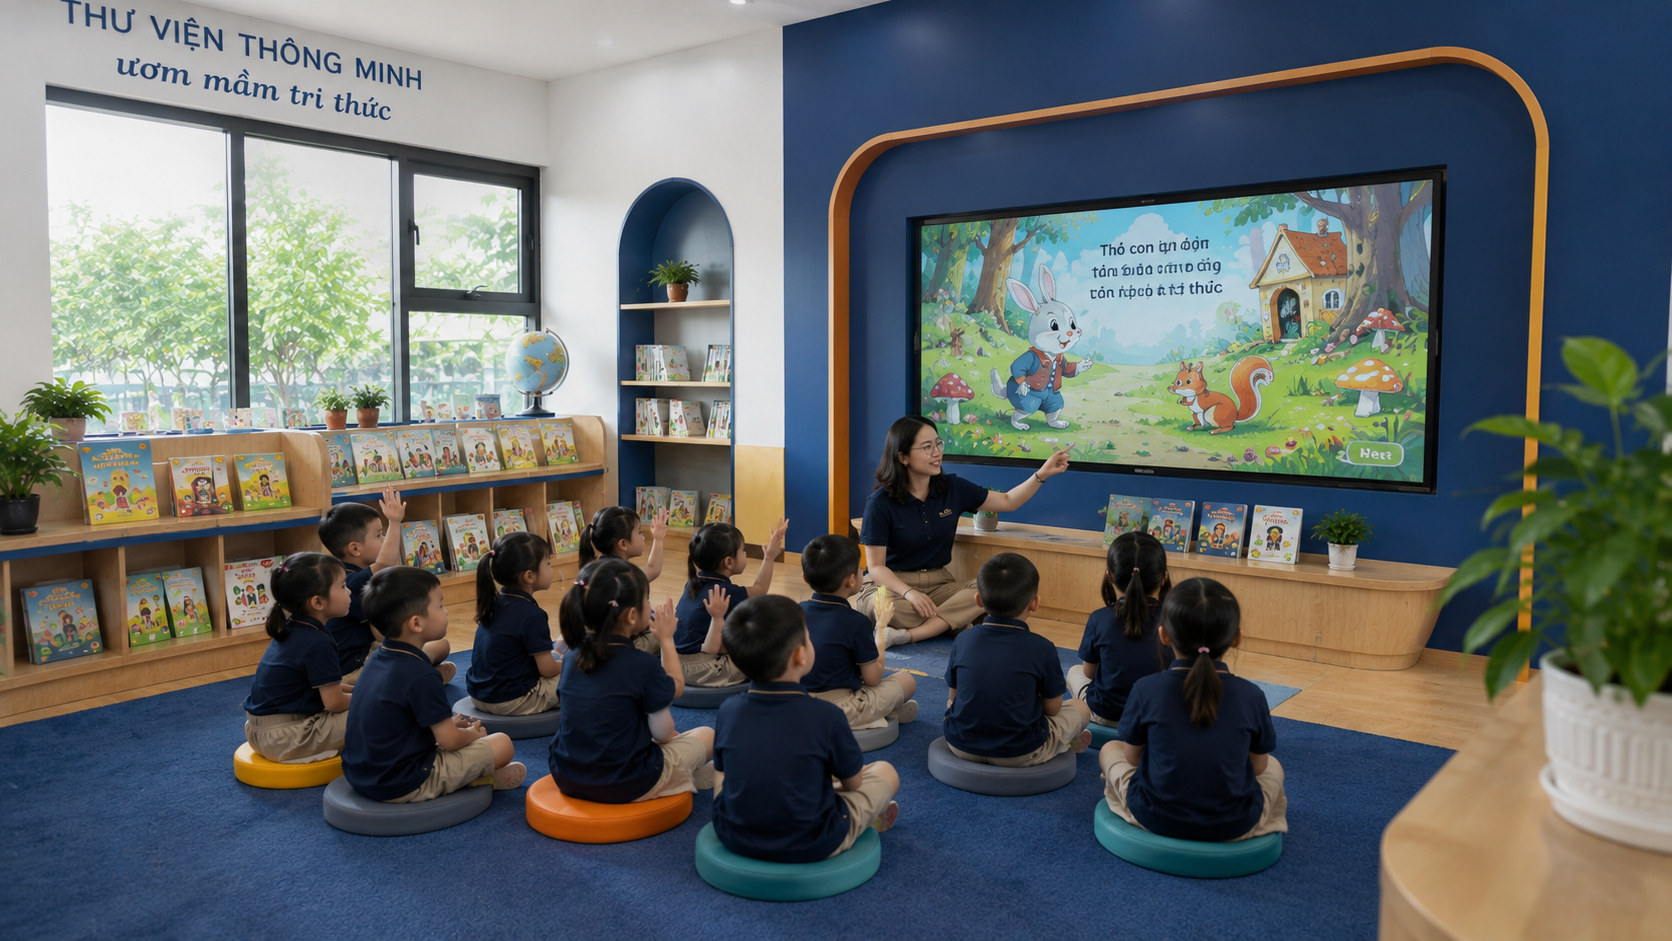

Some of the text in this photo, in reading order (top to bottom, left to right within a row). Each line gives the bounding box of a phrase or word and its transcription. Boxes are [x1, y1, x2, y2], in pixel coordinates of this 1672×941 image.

[60, 0, 423, 91] THƯ VIỆN THÔNG MINH
[116, 57, 392, 121] ươm mầm tri thức
[1130, 243, 1154, 255] con
